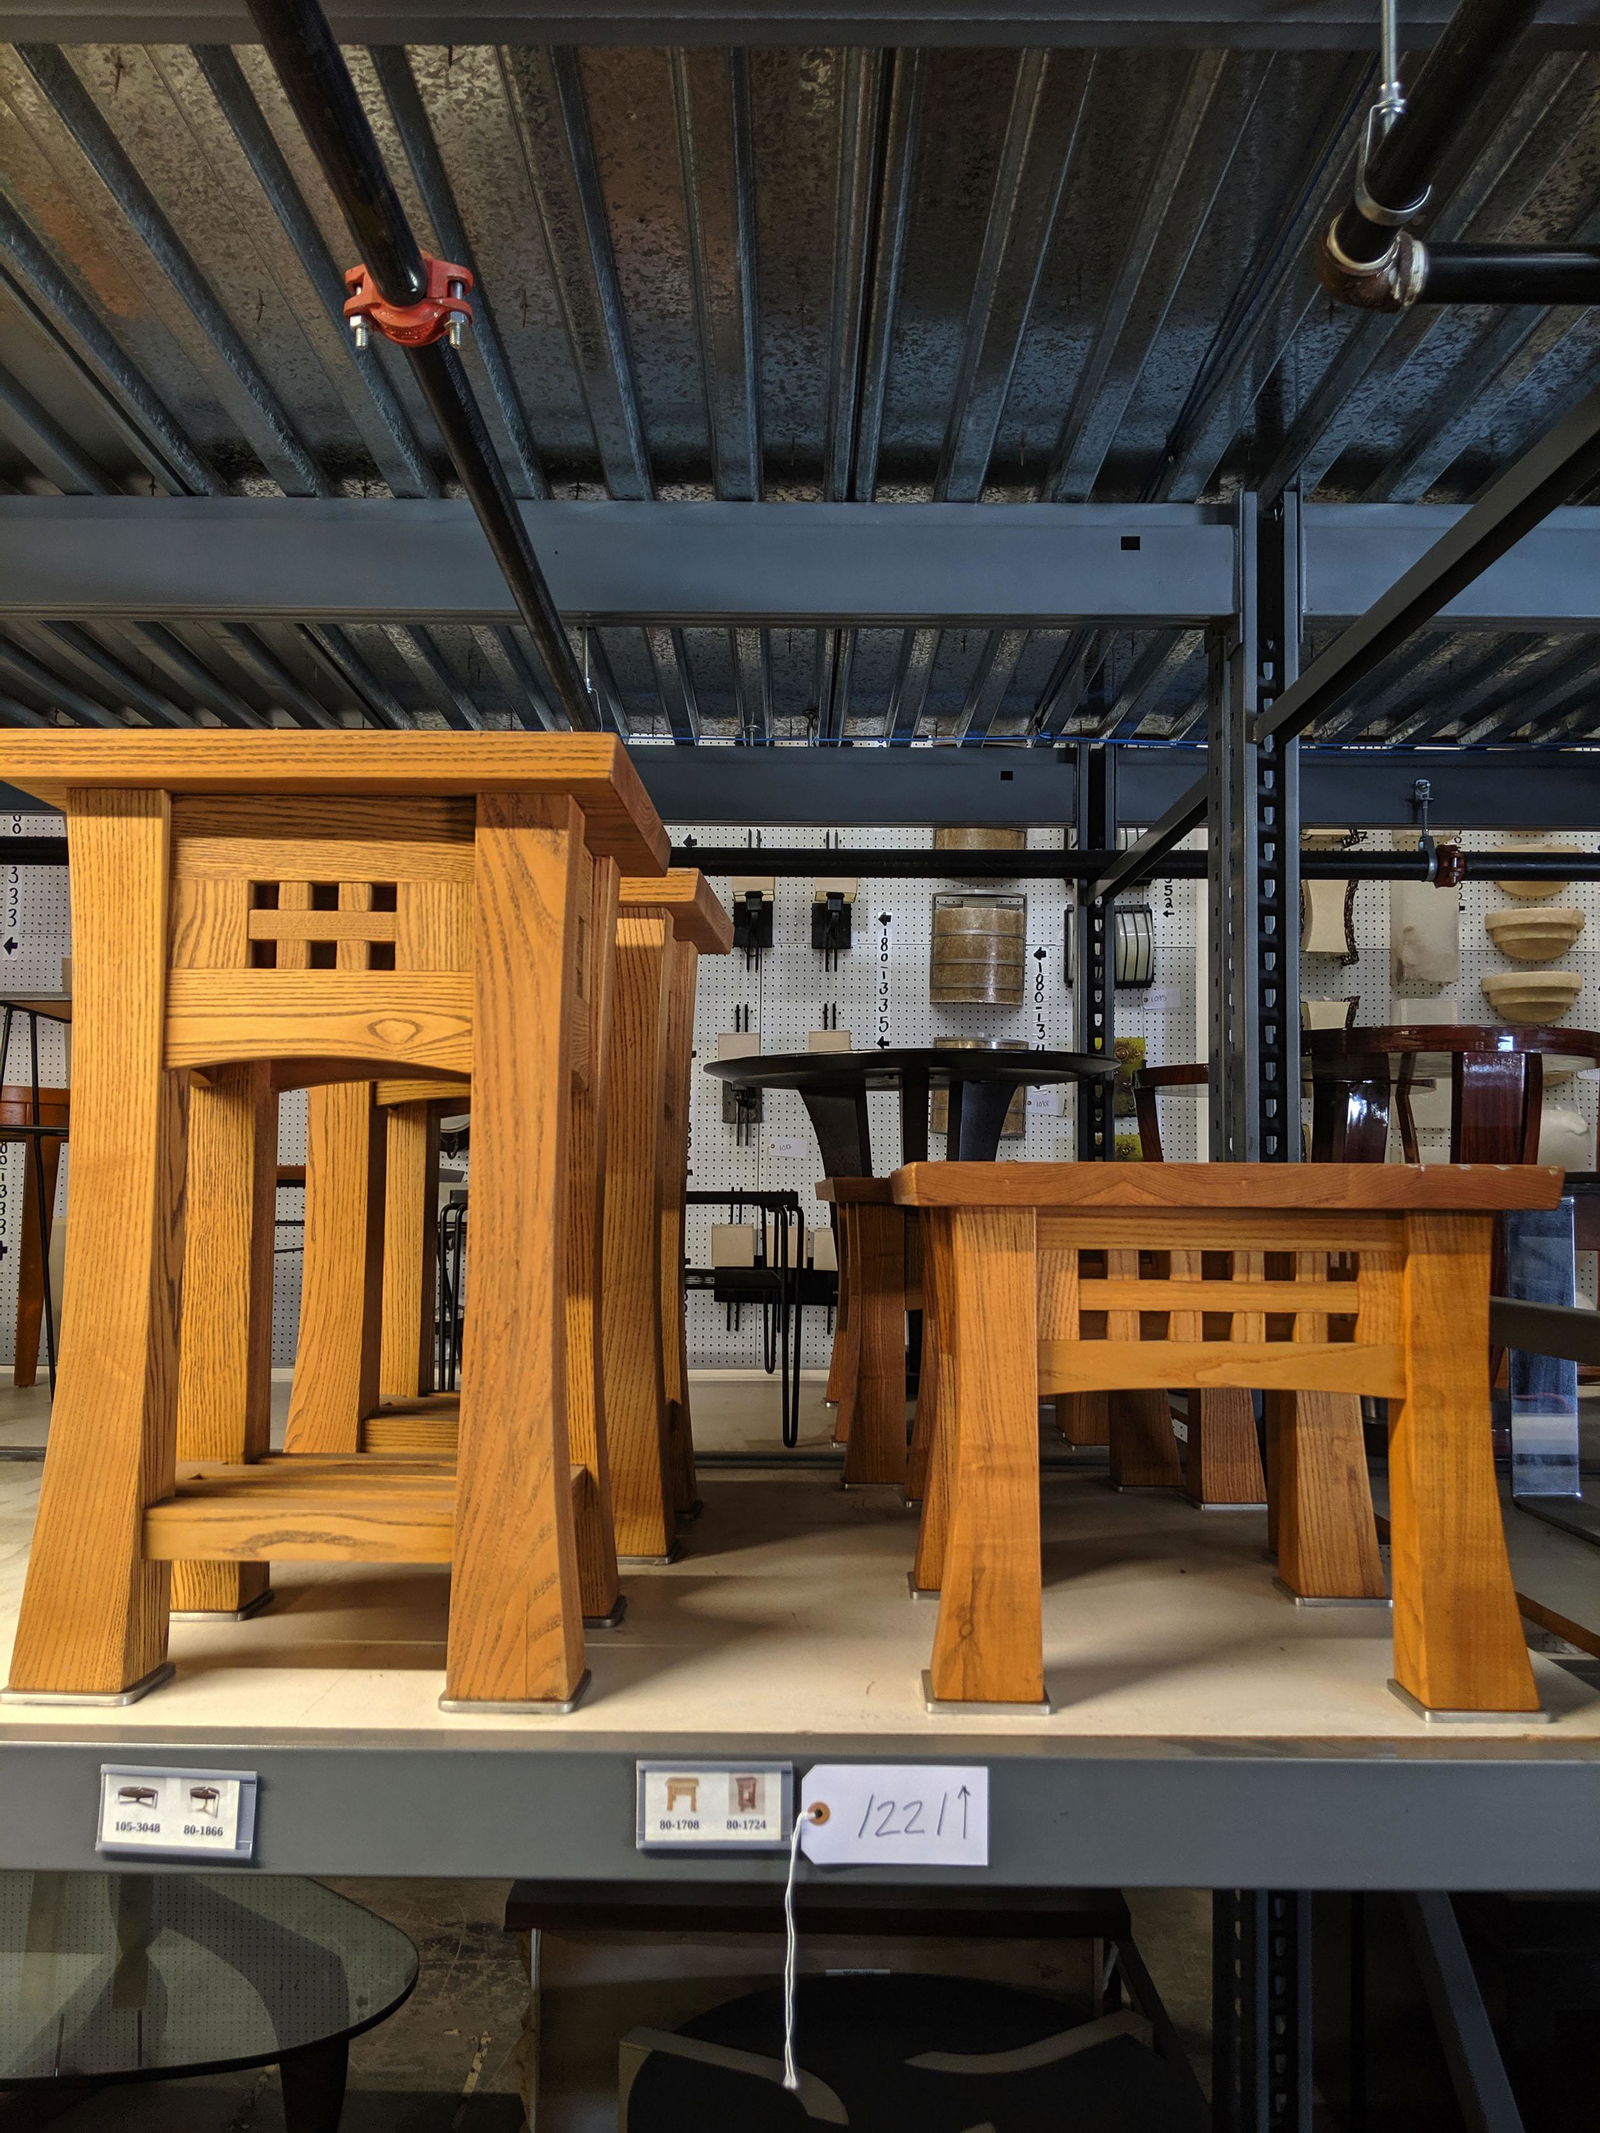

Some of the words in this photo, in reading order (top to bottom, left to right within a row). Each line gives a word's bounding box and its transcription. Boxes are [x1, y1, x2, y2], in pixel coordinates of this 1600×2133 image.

[857, 1792, 948, 1839] 1221
[115, 1821, 161, 1833] 105-3048
[183, 1824, 224, 1837] 80-1866
[659, 1819, 700, 1830] 80-1708
[726, 1819, 767, 1830] 80-1724
